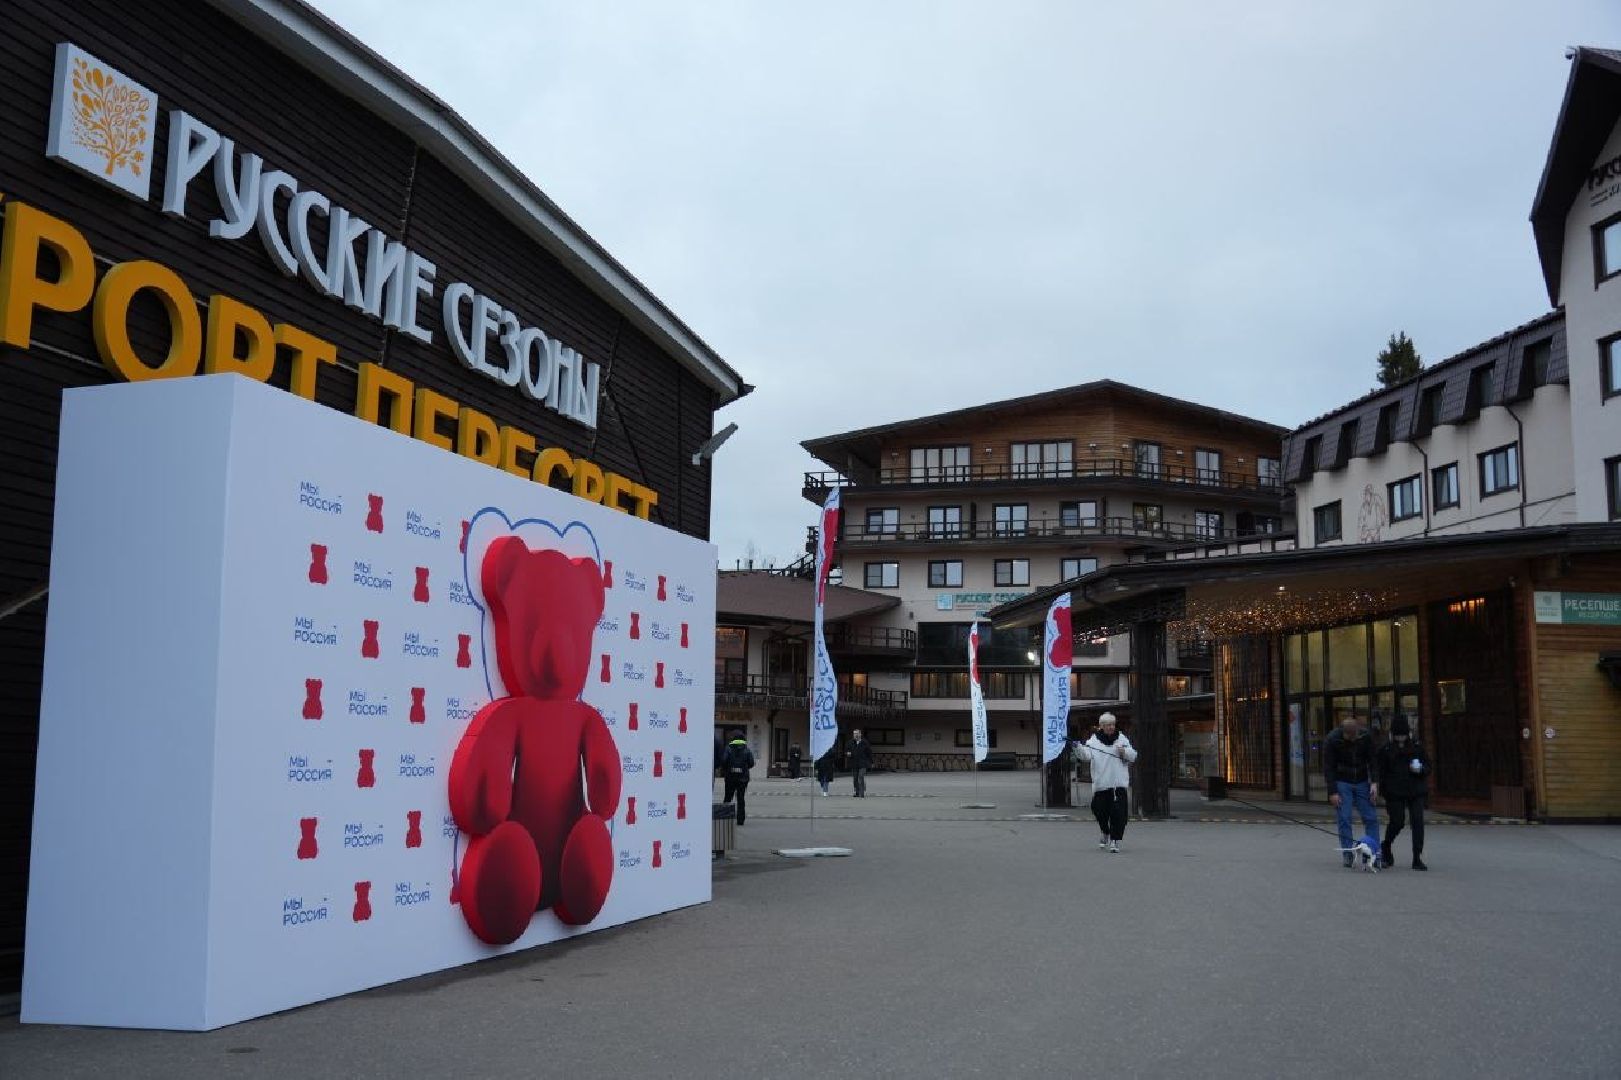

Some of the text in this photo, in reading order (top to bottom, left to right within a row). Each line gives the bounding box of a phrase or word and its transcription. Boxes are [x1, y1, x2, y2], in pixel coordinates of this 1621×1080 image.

[0, 192, 337, 402] РОРТ
[161, 110, 600, 430] РУССКИЕ СЕЗОНЫ
